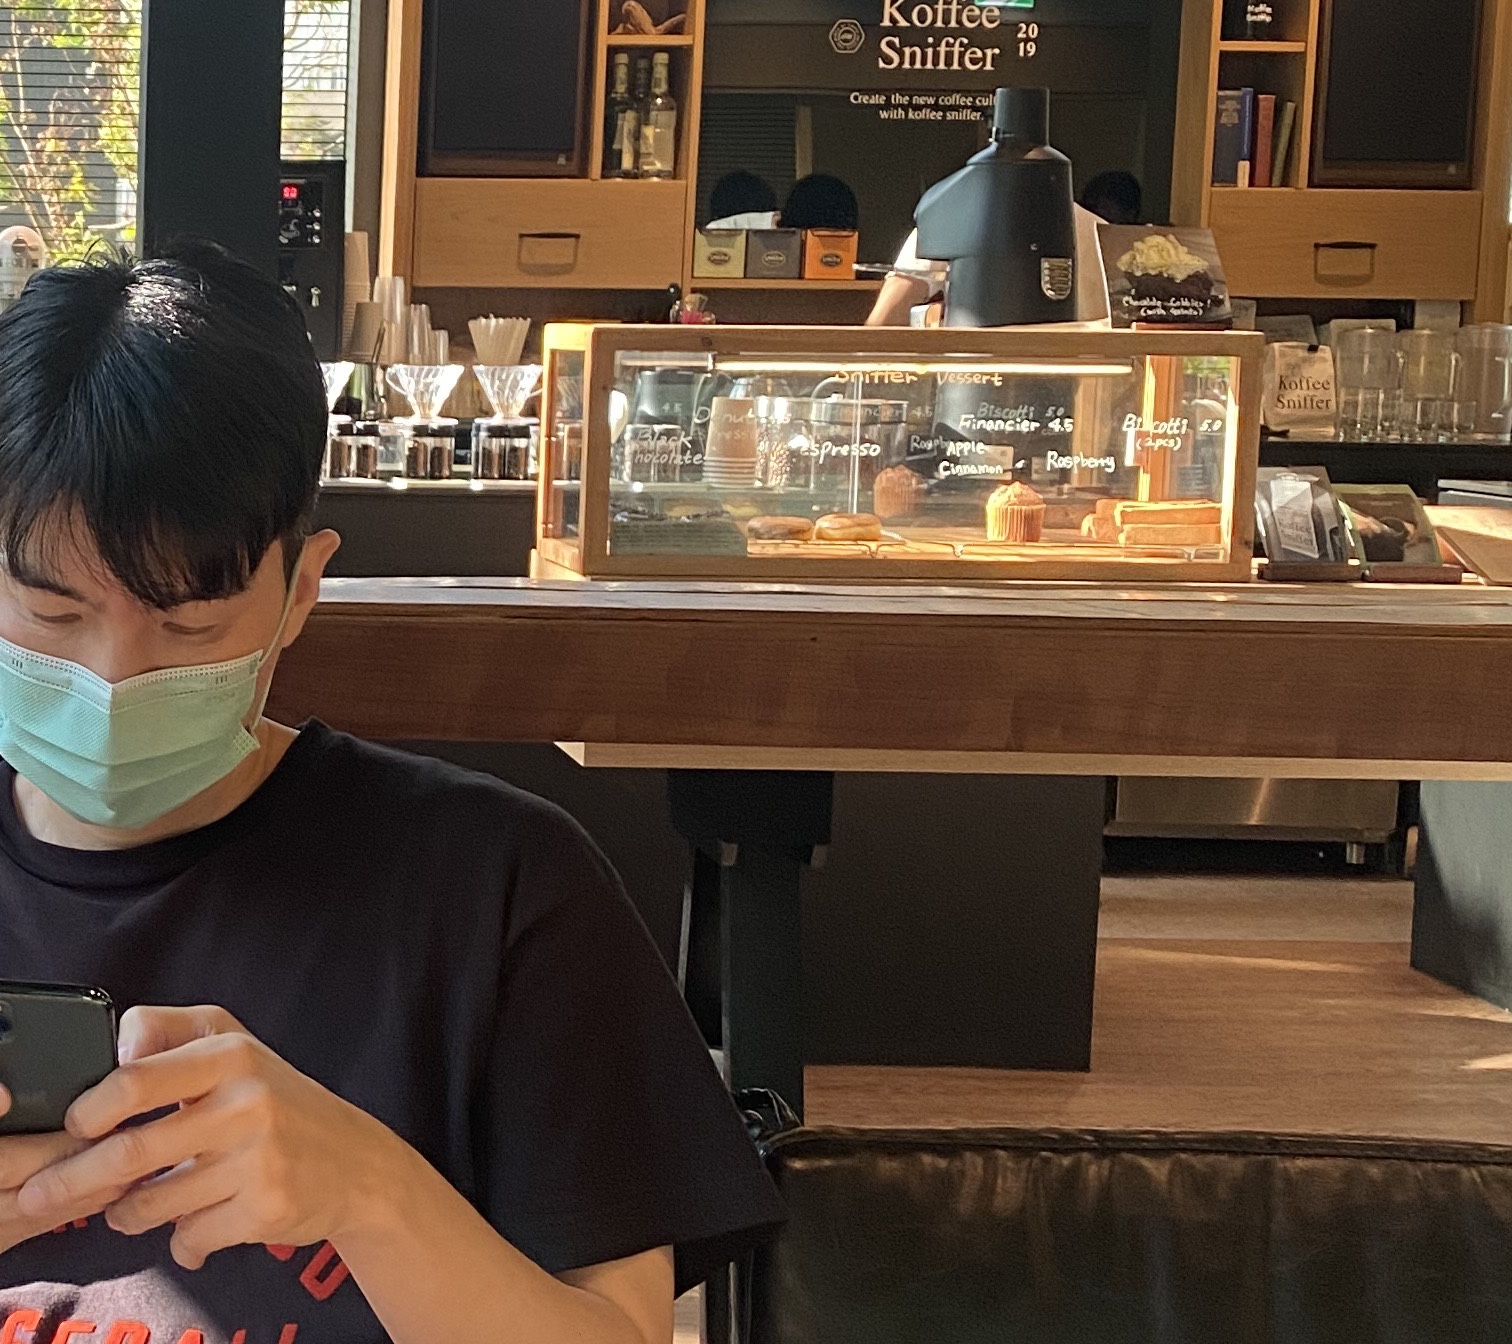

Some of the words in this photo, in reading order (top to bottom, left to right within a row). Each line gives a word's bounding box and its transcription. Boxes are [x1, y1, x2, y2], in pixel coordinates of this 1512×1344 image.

[1016, 22, 1039, 39] 20
[877, 36, 1001, 71] Sniffer
[1017, 40, 1037, 57] 19
[849, 91, 887, 105] Create
[890, 92, 910, 105] the
[912, 94, 937, 105] new
[938, 93, 974, 106] coffee
[879, 107, 906, 120] with
[907, 107, 944, 120] koffee
[1277, 373, 1331, 391] Koffee
[1275, 393, 1333, 410] Sniffer
[958, 413, 1041, 433] Financier
[1048, 417, 1075, 433] 4.5
[1199, 419, 1223, 432] 5.0
[938, 460, 1004, 477] Cinnamon
[1046, 450, 1116, 474] Raspberry
